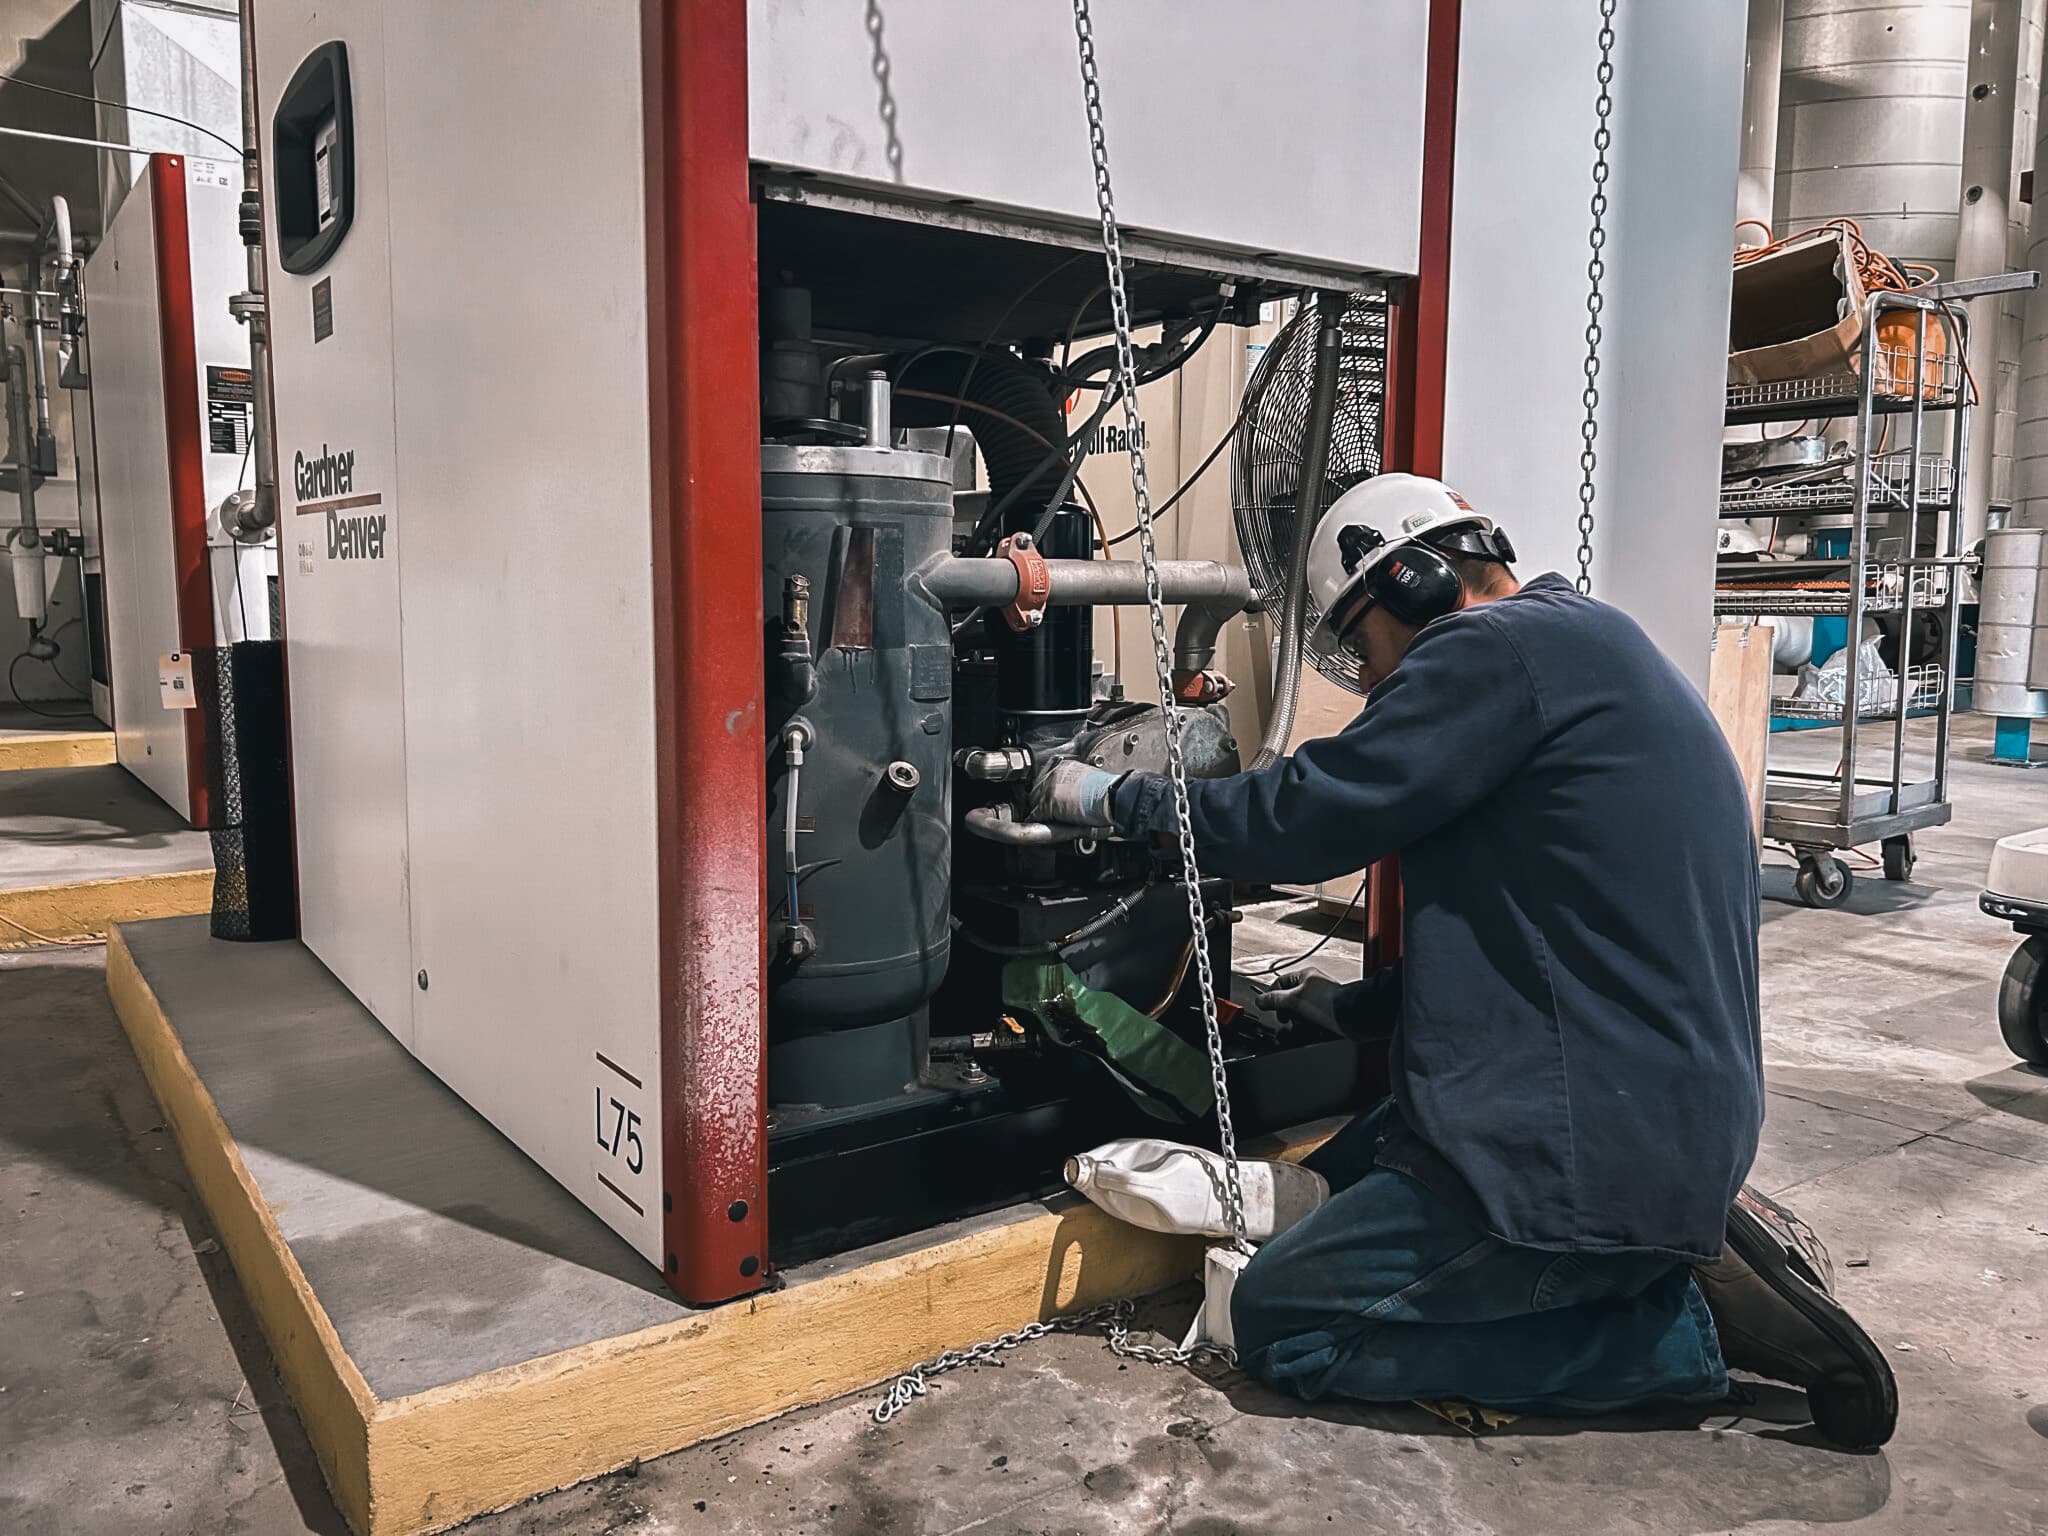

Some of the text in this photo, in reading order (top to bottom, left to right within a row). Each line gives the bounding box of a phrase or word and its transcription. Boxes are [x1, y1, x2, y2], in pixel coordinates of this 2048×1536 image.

[295, 443, 354, 502] Gardner
[326, 508, 386, 560] Denver
[1400, 570, 1415, 584] 105
[596, 1086, 643, 1175] L75
